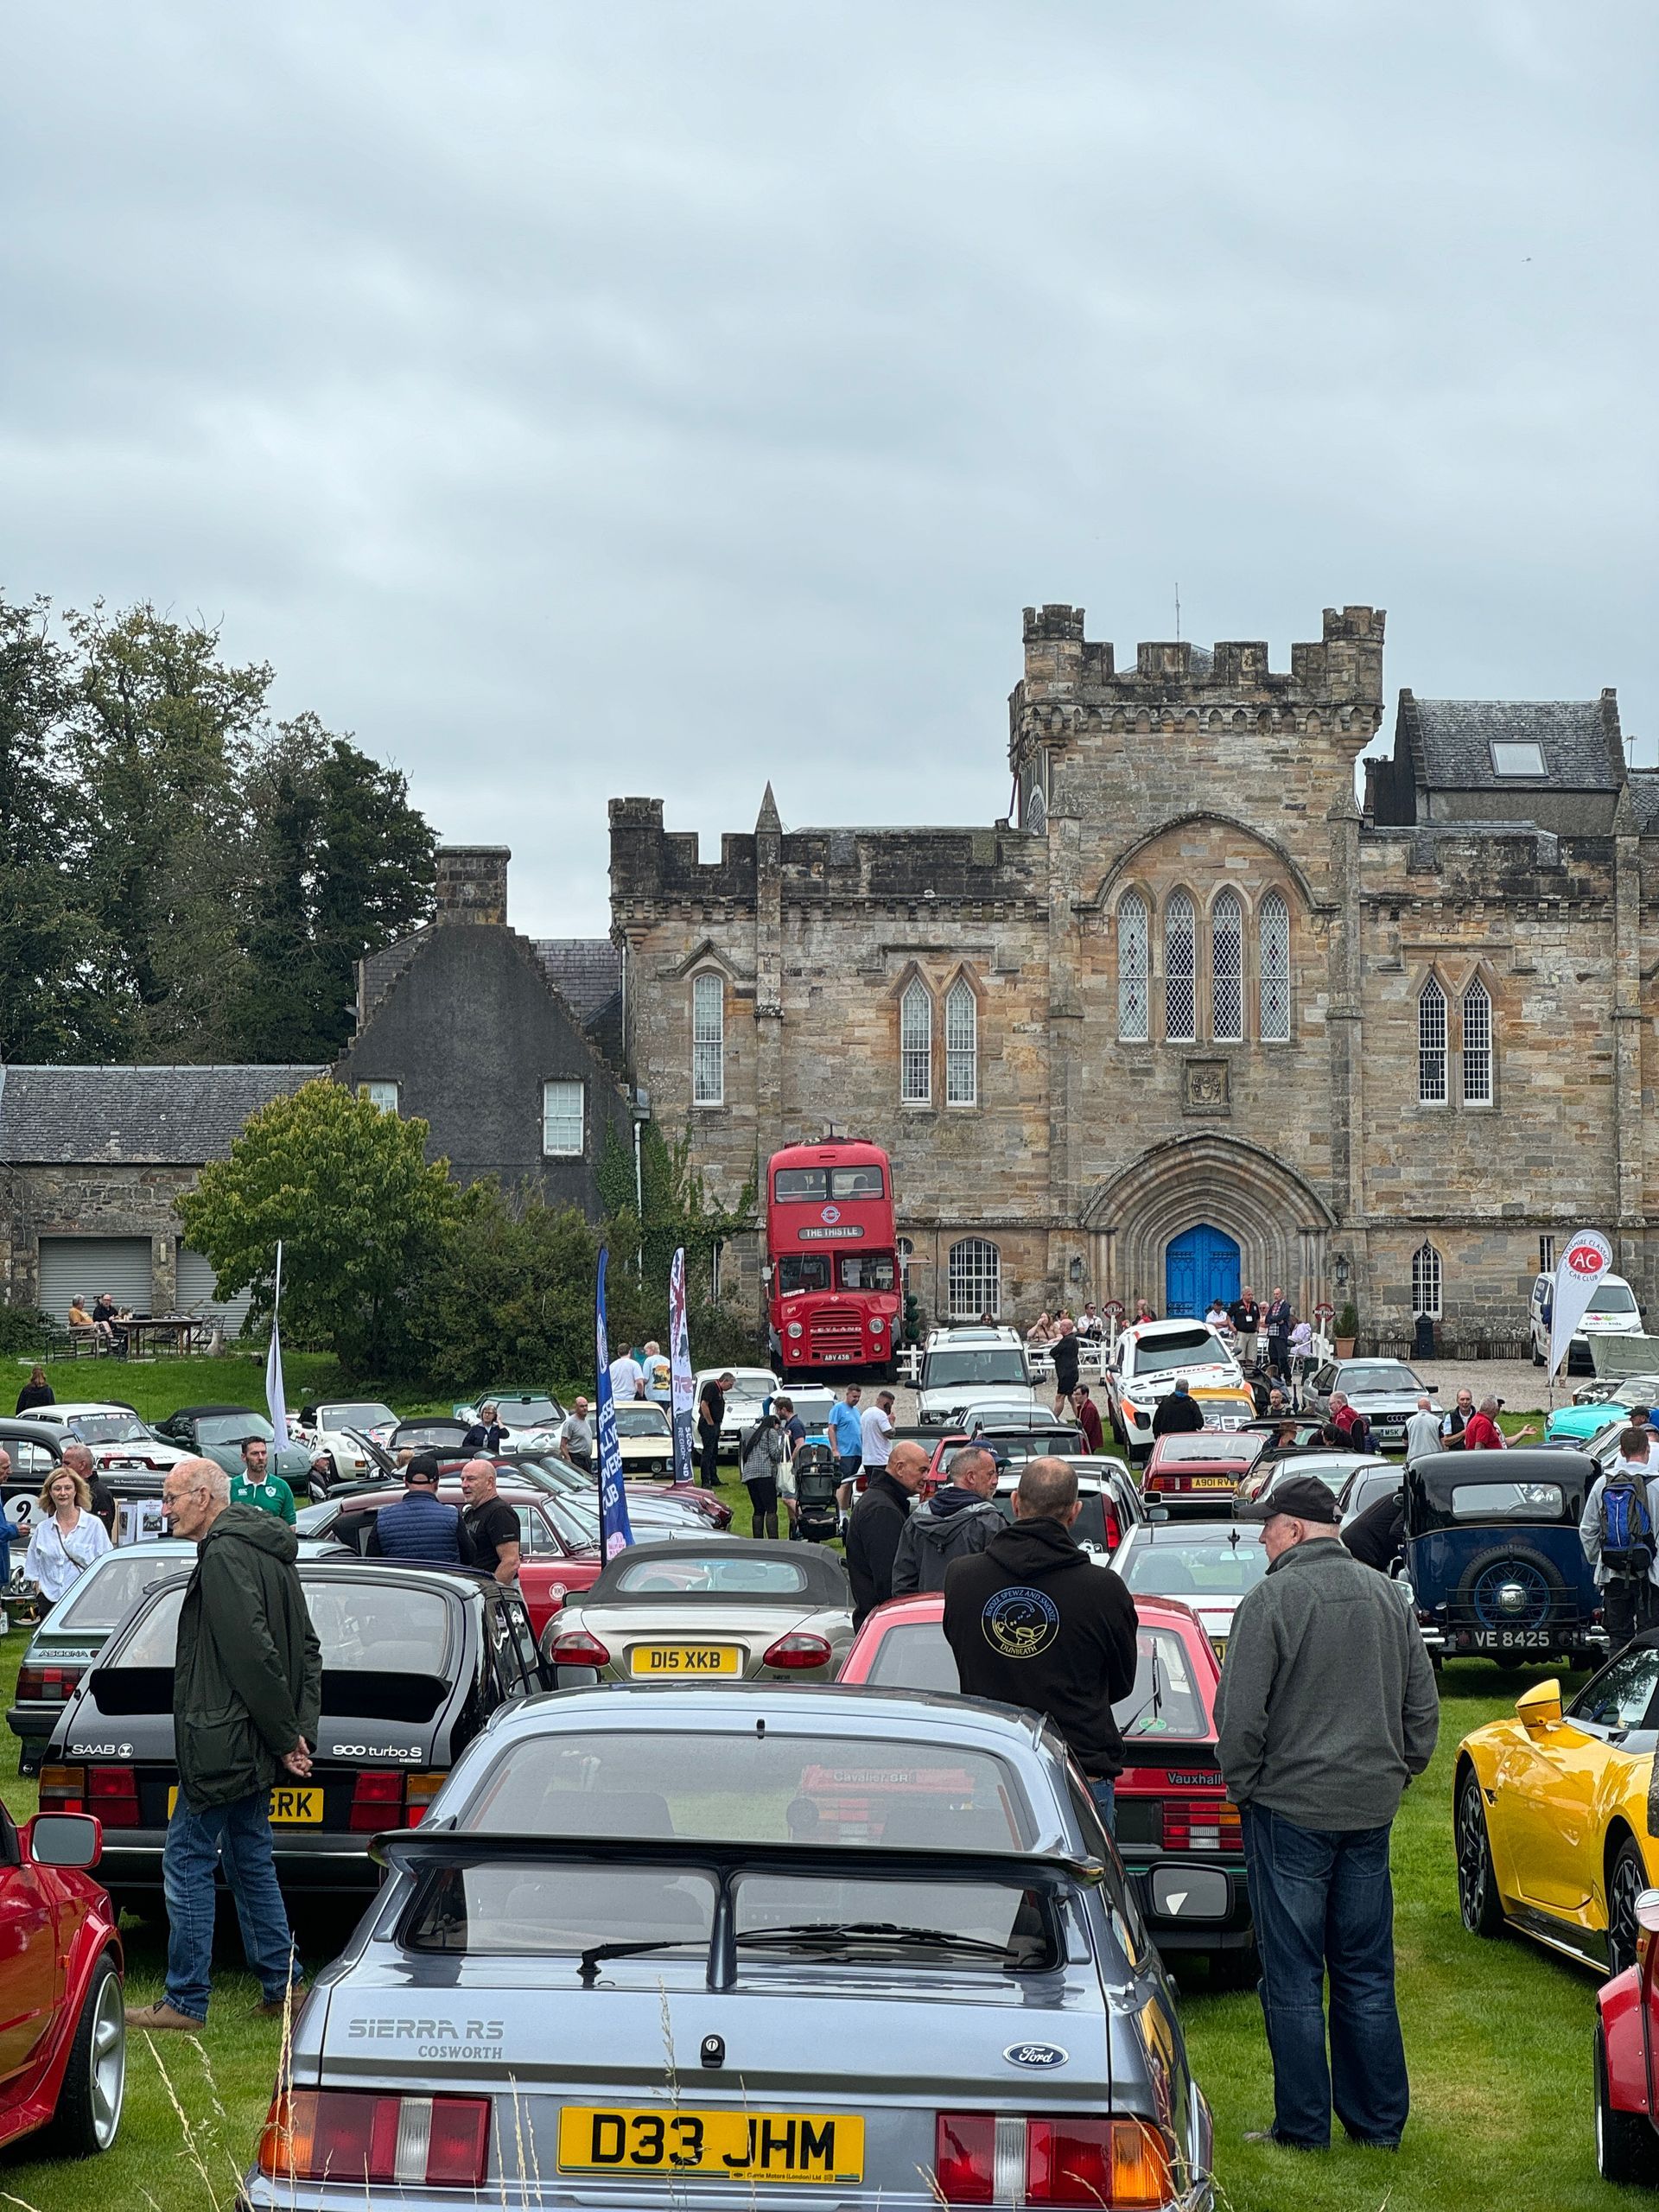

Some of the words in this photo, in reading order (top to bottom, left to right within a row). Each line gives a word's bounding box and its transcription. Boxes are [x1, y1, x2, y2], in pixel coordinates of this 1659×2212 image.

[805, 1229, 823, 1237] THE
[824, 1227, 858, 1236] THISTLE
[1573, 1252, 1598, 1269] AC
[1569, 1271, 1581, 1281] CAR
[1195, 1478, 1216, 1487] A901
[985, 1596, 1002, 1618] BOOZE
[1001, 1589, 1024, 1599] SPEWZ
[1024, 1590, 1041, 1600] AND
[1039, 1597, 1057, 1623] SNOOZE
[1474, 1630, 1498, 1648] VE
[1502, 1630, 1550, 1648] 8425
[1000, 1643, 1039, 1656] DUNBEATH
[651, 1651, 679, 1669] D15
[684, 1651, 721, 1669] XKB
[71, 1744, 117, 1755] SAAB
[332, 1745, 366, 1757] 900
[368, 1745, 409, 1758] turbo
[410, 1746, 423, 1758] S
[833, 1770, 887, 1783] Cavalier
[1166, 1771, 1222, 1786] Vauxhall
[348, 2018, 460, 2039] SIERRA
[466, 2019, 505, 2040] RS
[417, 2045, 503, 2060] COSWORTH
[1019, 2046, 1054, 2063] Ford
[591, 2113, 704, 2166] D33
[721, 2119, 836, 2171] JHM
